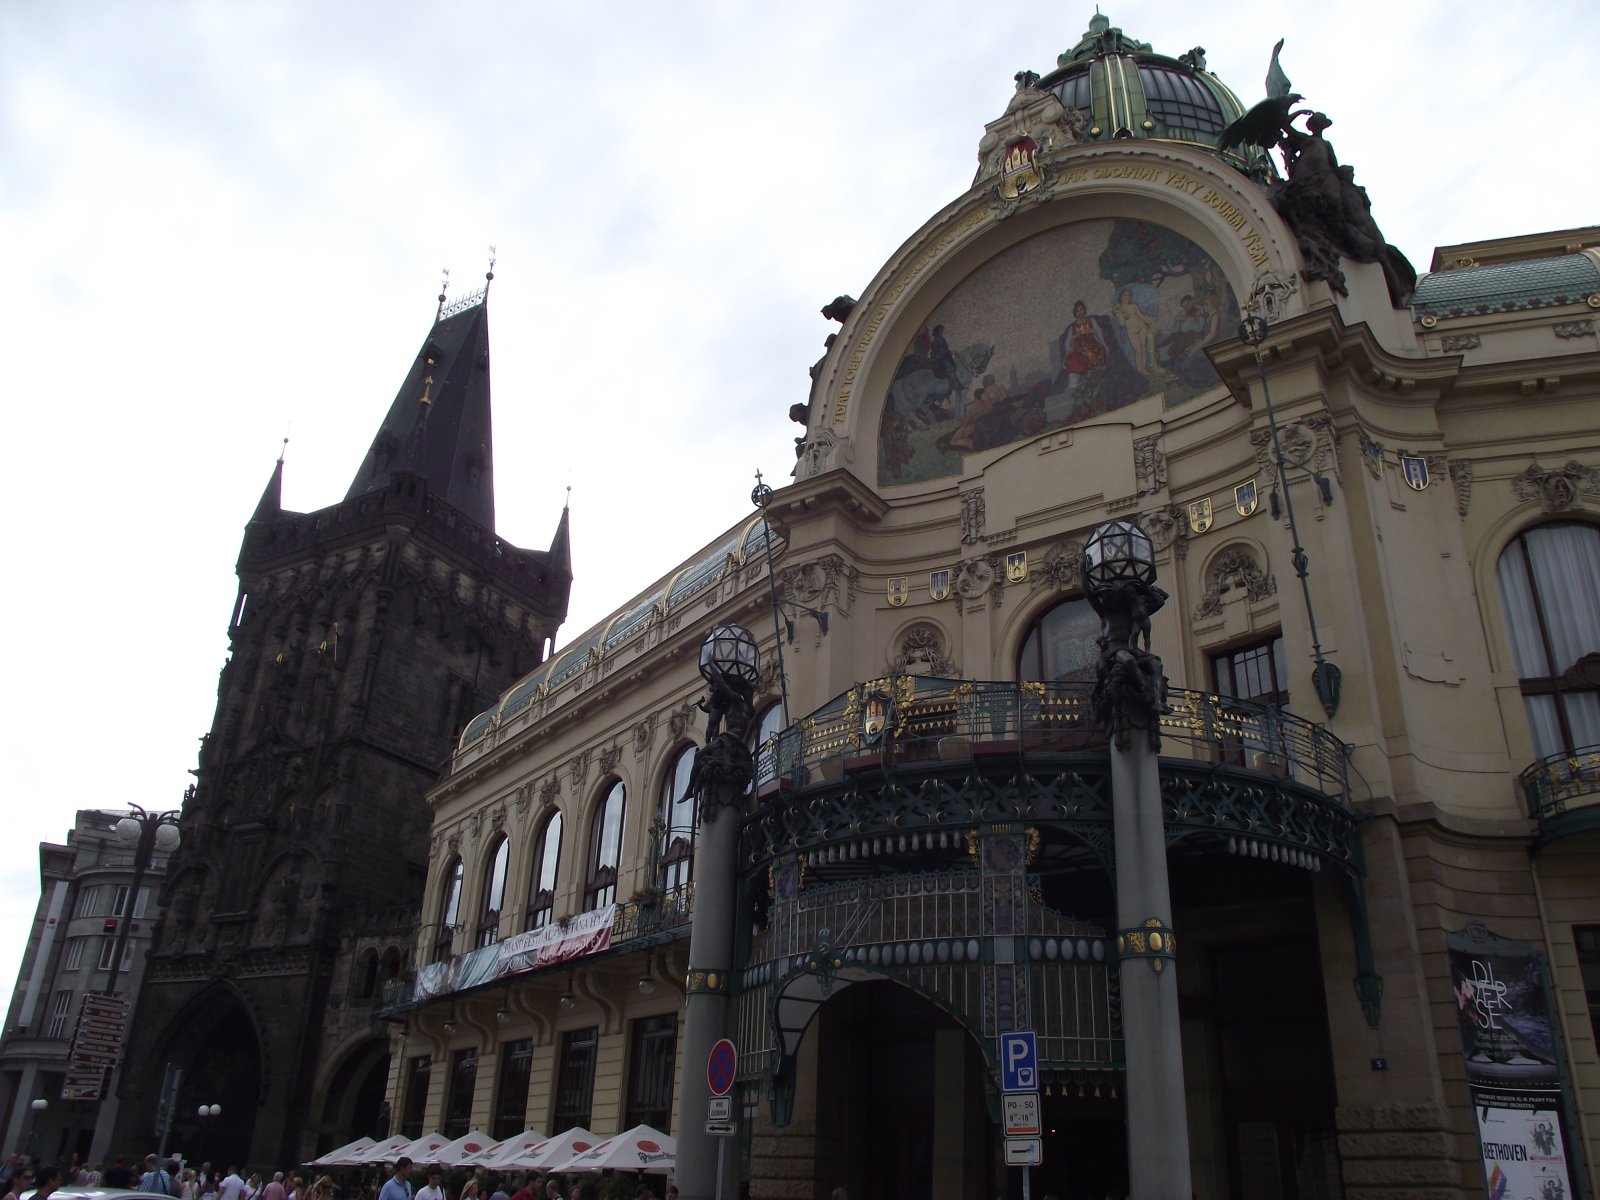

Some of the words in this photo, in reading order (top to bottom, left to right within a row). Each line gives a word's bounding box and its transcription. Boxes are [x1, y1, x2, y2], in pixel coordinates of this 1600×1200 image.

[1008, 1039, 1028, 1072] P
[1007, 1101, 1017, 1109] PO
[1482, 1142, 1528, 1162] BEETHOVEN
